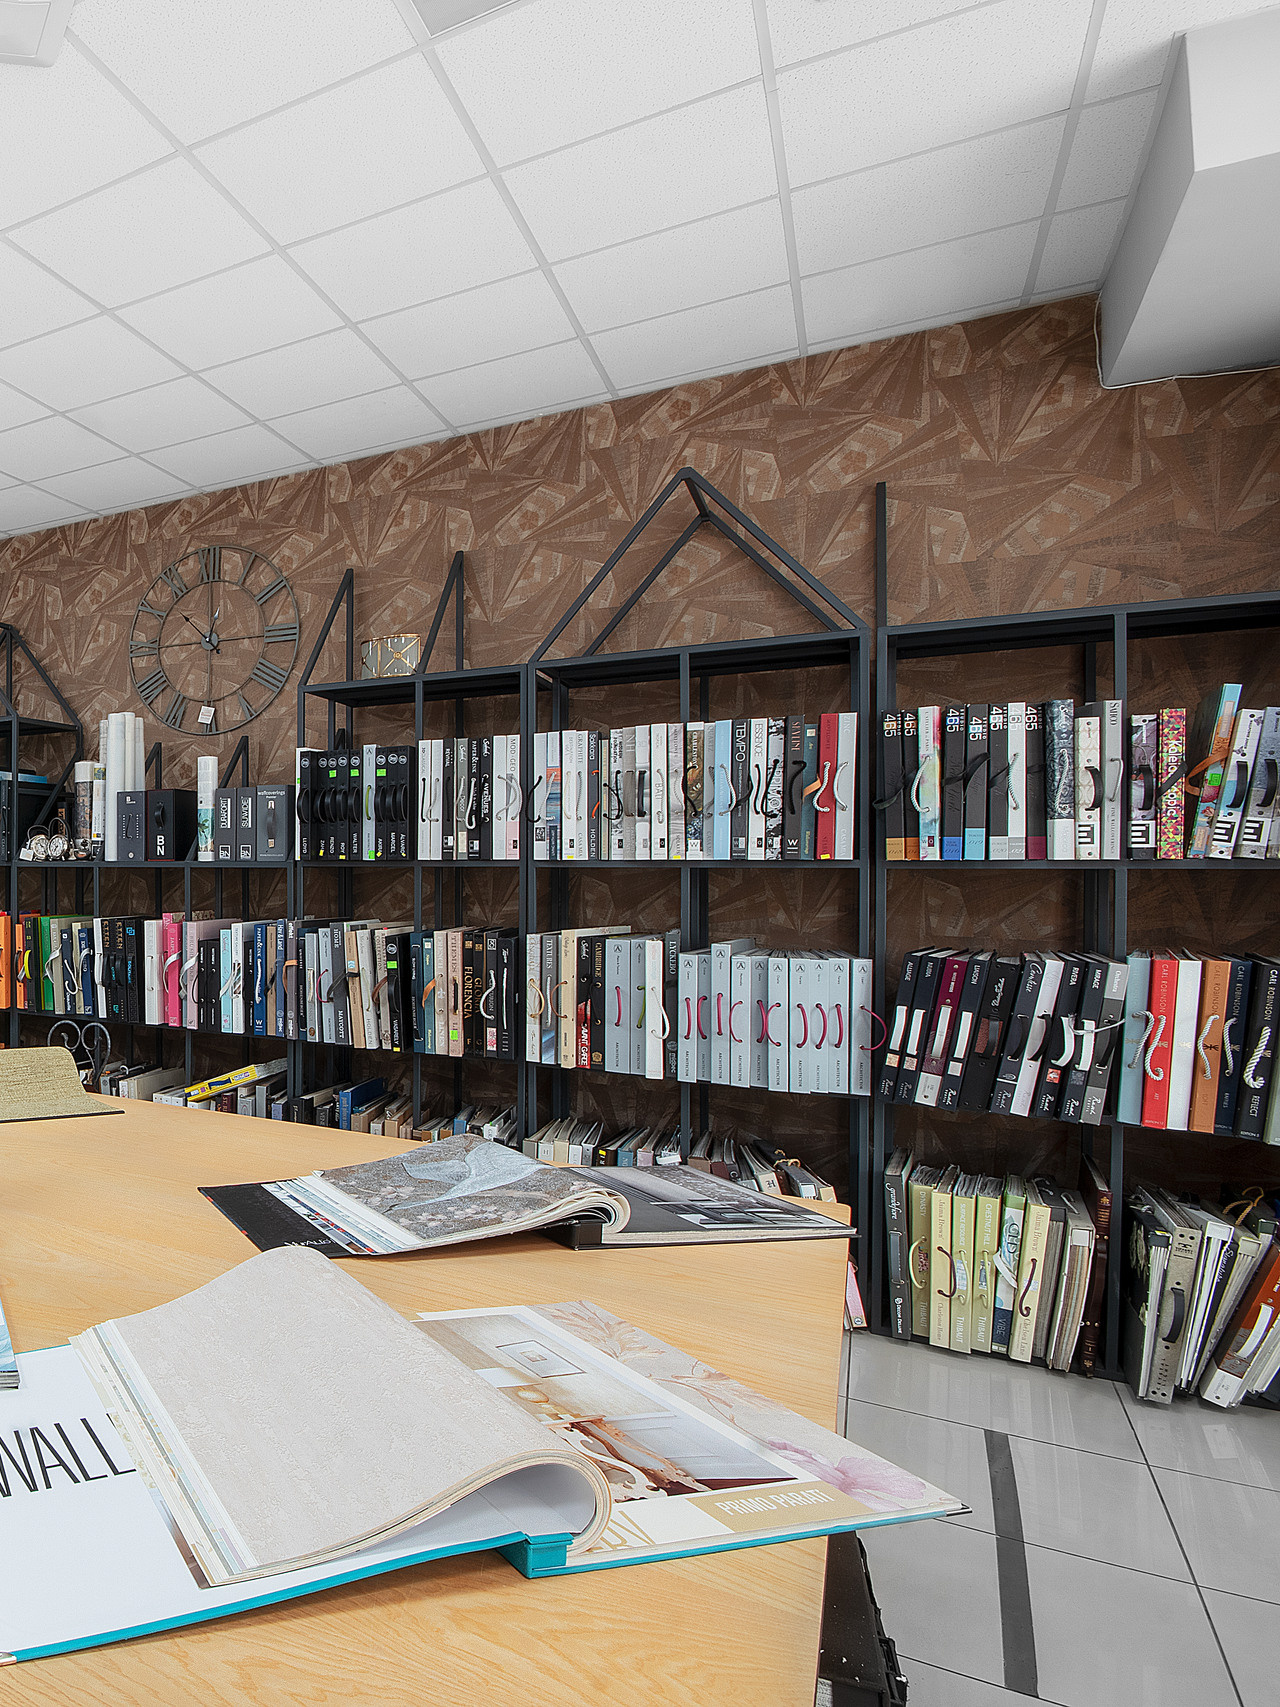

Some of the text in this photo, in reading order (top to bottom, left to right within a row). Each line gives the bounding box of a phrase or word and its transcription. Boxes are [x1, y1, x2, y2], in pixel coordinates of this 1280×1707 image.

[843, 715, 851, 734] ZINC
[883, 714, 896, 737] 465
[904, 713, 917, 737] 465
[946, 708, 960, 732] 465
[990, 706, 1003, 731] 465
[1025, 706, 1038, 731] 465
[1109, 702, 1119, 725] SAHCO
[735, 722, 746, 762] TEMPO
[754, 723, 763, 758] ESSENCE
[791, 721, 801, 751] SKYLINE
[969, 716, 983, 741] 465
[471, 740, 479, 773] PAPER&INK
[287, 922, 295, 939] effekt
[546, 939, 556, 969] TEXTURES
[668, 940, 677, 975] LYCKEBO
[970, 964, 981, 985] LIAISON
[1091, 969, 1102, 990] MIRAGE
[1111, 969, 1122, 993] Orchestra
[1159, 963, 1170, 1013] CARL ROBINSON
[464, 966, 473, 1019] FLORENCIA
[1211, 964, 1221, 1015] CARL ROBINSON
[1232, 965, 1245, 1016] CARL ROBINSON
[1263, 969, 1278, 1021] CARL ROBINSON
[1249, 1095, 1260, 1117] REFLECT
[919, 1191, 927, 1217] DYNASTY
[937, 1199, 946, 1239] Jaima Brown
[983, 1203, 993, 1246] CHESTNUT HILL
[1031, 1211, 1045, 1252] Jaima Brown
[919, 1301, 928, 1328] THIBAUT
[996, 1318, 1007, 1335] VIBE
[955, 1316, 964, 1343] THIBAUT
[976, 1316, 987, 1343] THIBAUT
[1022, 1318, 1032, 1341] Chelsea
